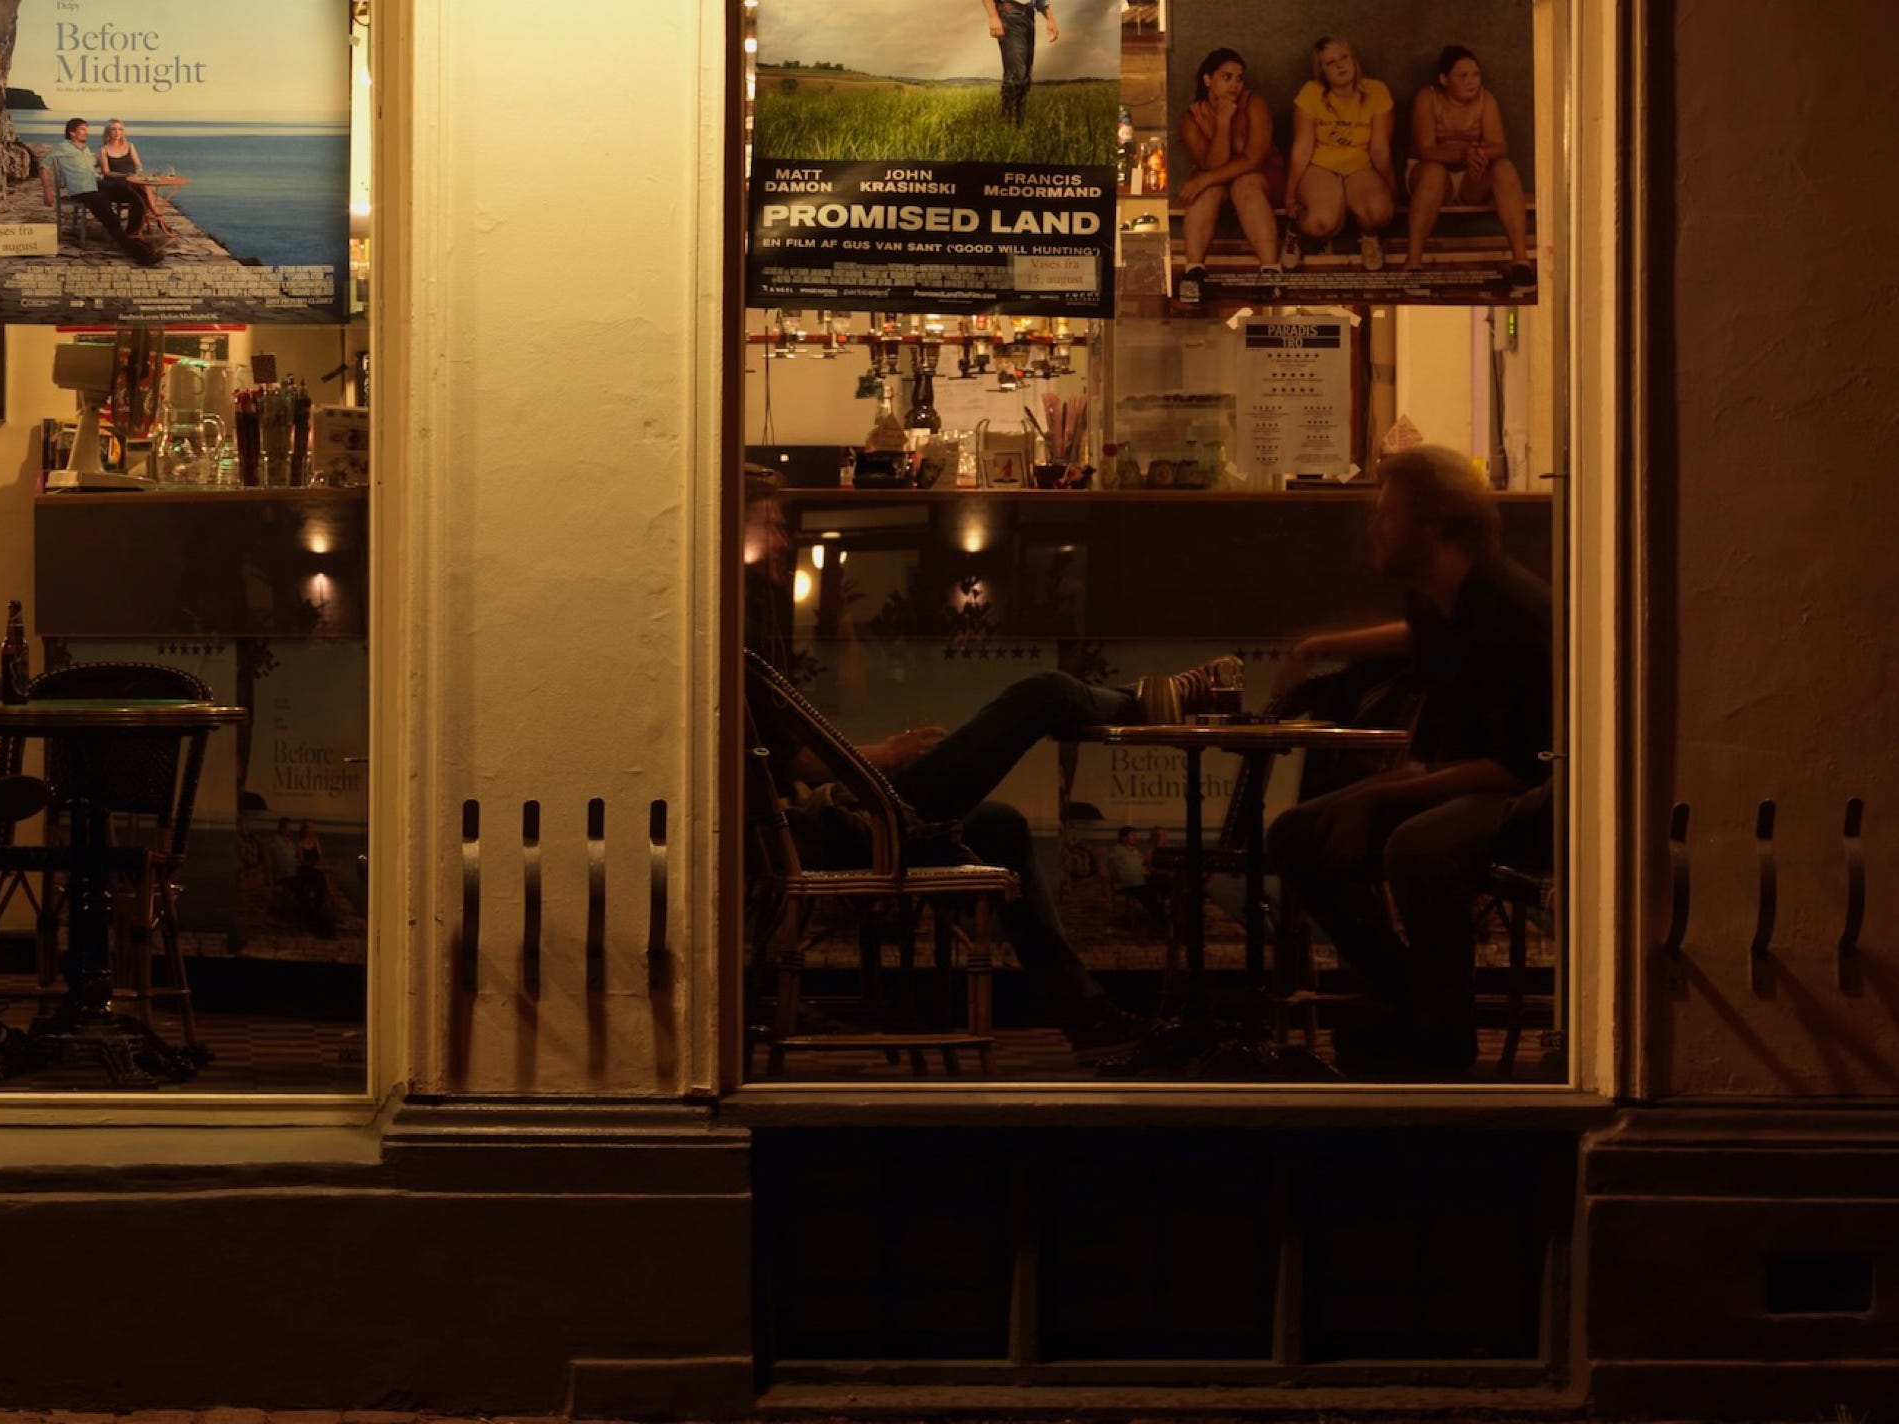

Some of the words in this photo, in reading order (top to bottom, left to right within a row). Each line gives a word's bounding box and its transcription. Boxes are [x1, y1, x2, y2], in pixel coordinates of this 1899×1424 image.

[54, 21, 160, 52] Before
[54, 54, 208, 94] Midnight
[775, 168, 823, 182] MATT
[883, 169, 934, 183] JOHN
[1003, 173, 1083, 187] FRANCIS
[764, 181, 833, 194] DAMON
[859, 182, 958, 196] KRASINSKI
[983, 185, 1103, 199] McDORMAND
[762, 204, 981, 234] PROMISED
[990, 209, 1102, 237] LAND
[17, 225, 34, 237] fra
[2, 241, 38, 254] august
[762, 238, 781, 248] EN
[785, 238, 816, 249] FILM
[821, 239, 839, 249] AF
[843, 240, 870, 251] GUS
[875, 241, 902, 252] VAN
[907, 241, 943, 253] SANT
[998, 244, 1028, 255] WILL
[1030, 258, 1062, 270] Vises
[1064, 259, 1080, 270] fra
[1045, 275, 1083, 287] august
[1267, 324, 1319, 338] PARADIS
[1282, 337, 1304, 349] TRO
